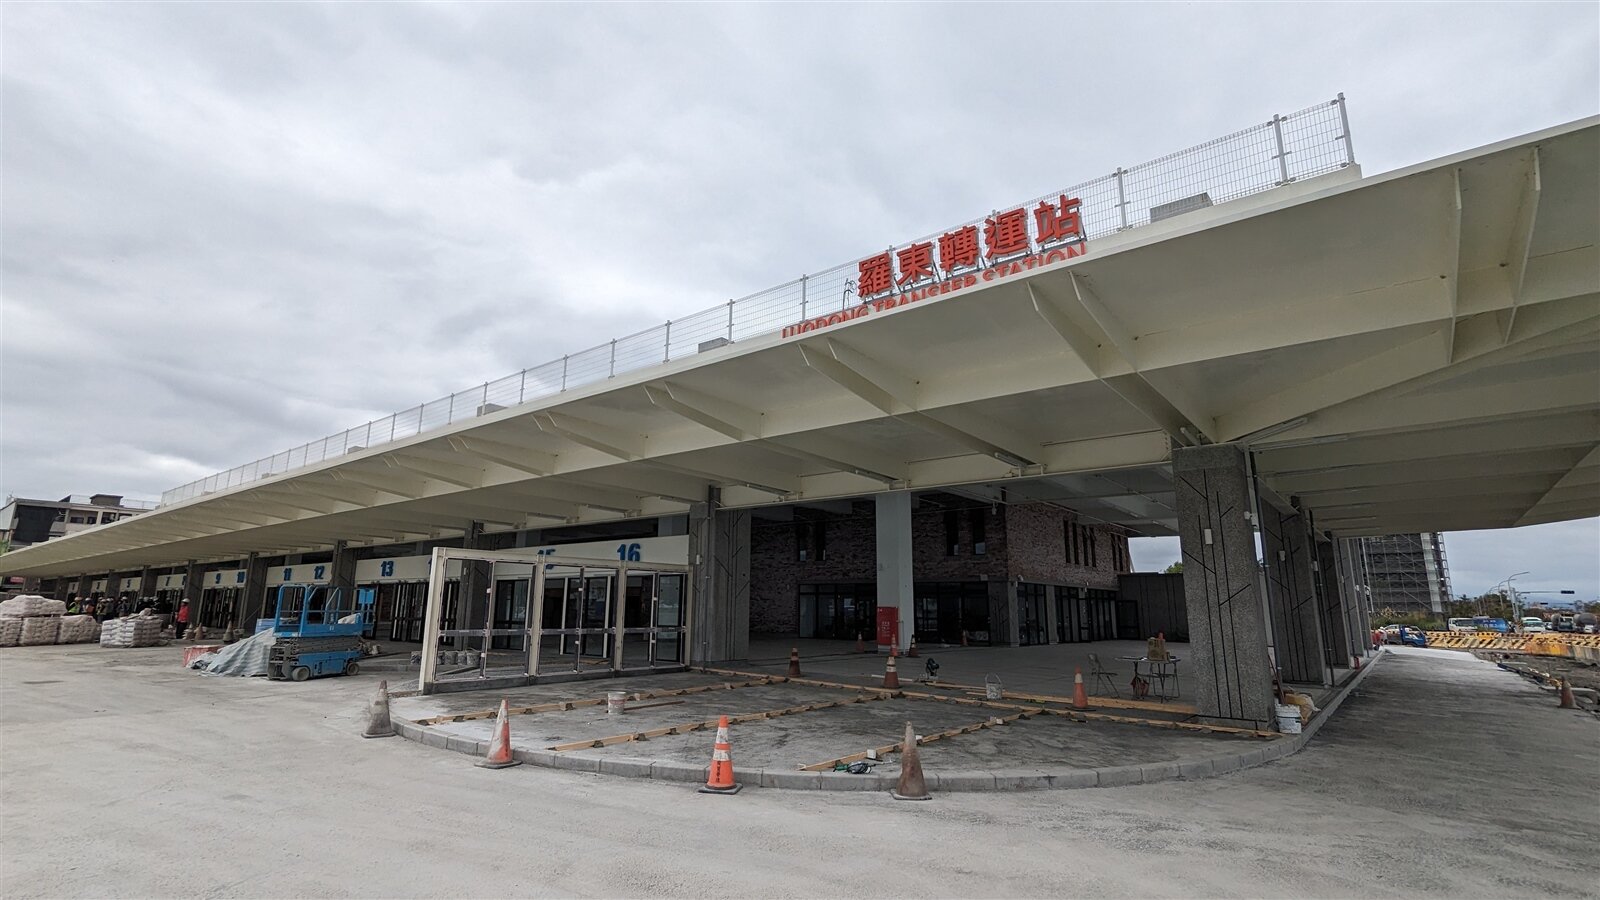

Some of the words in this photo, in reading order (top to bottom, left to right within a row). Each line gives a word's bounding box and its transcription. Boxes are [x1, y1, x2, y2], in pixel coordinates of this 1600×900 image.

[858, 194, 1083, 298] 羅東轉運站
[617, 543, 641, 562] 16
[283, 567, 292, 581] 11
[314, 565, 325, 580] 12
[381, 560, 394, 577] 13
